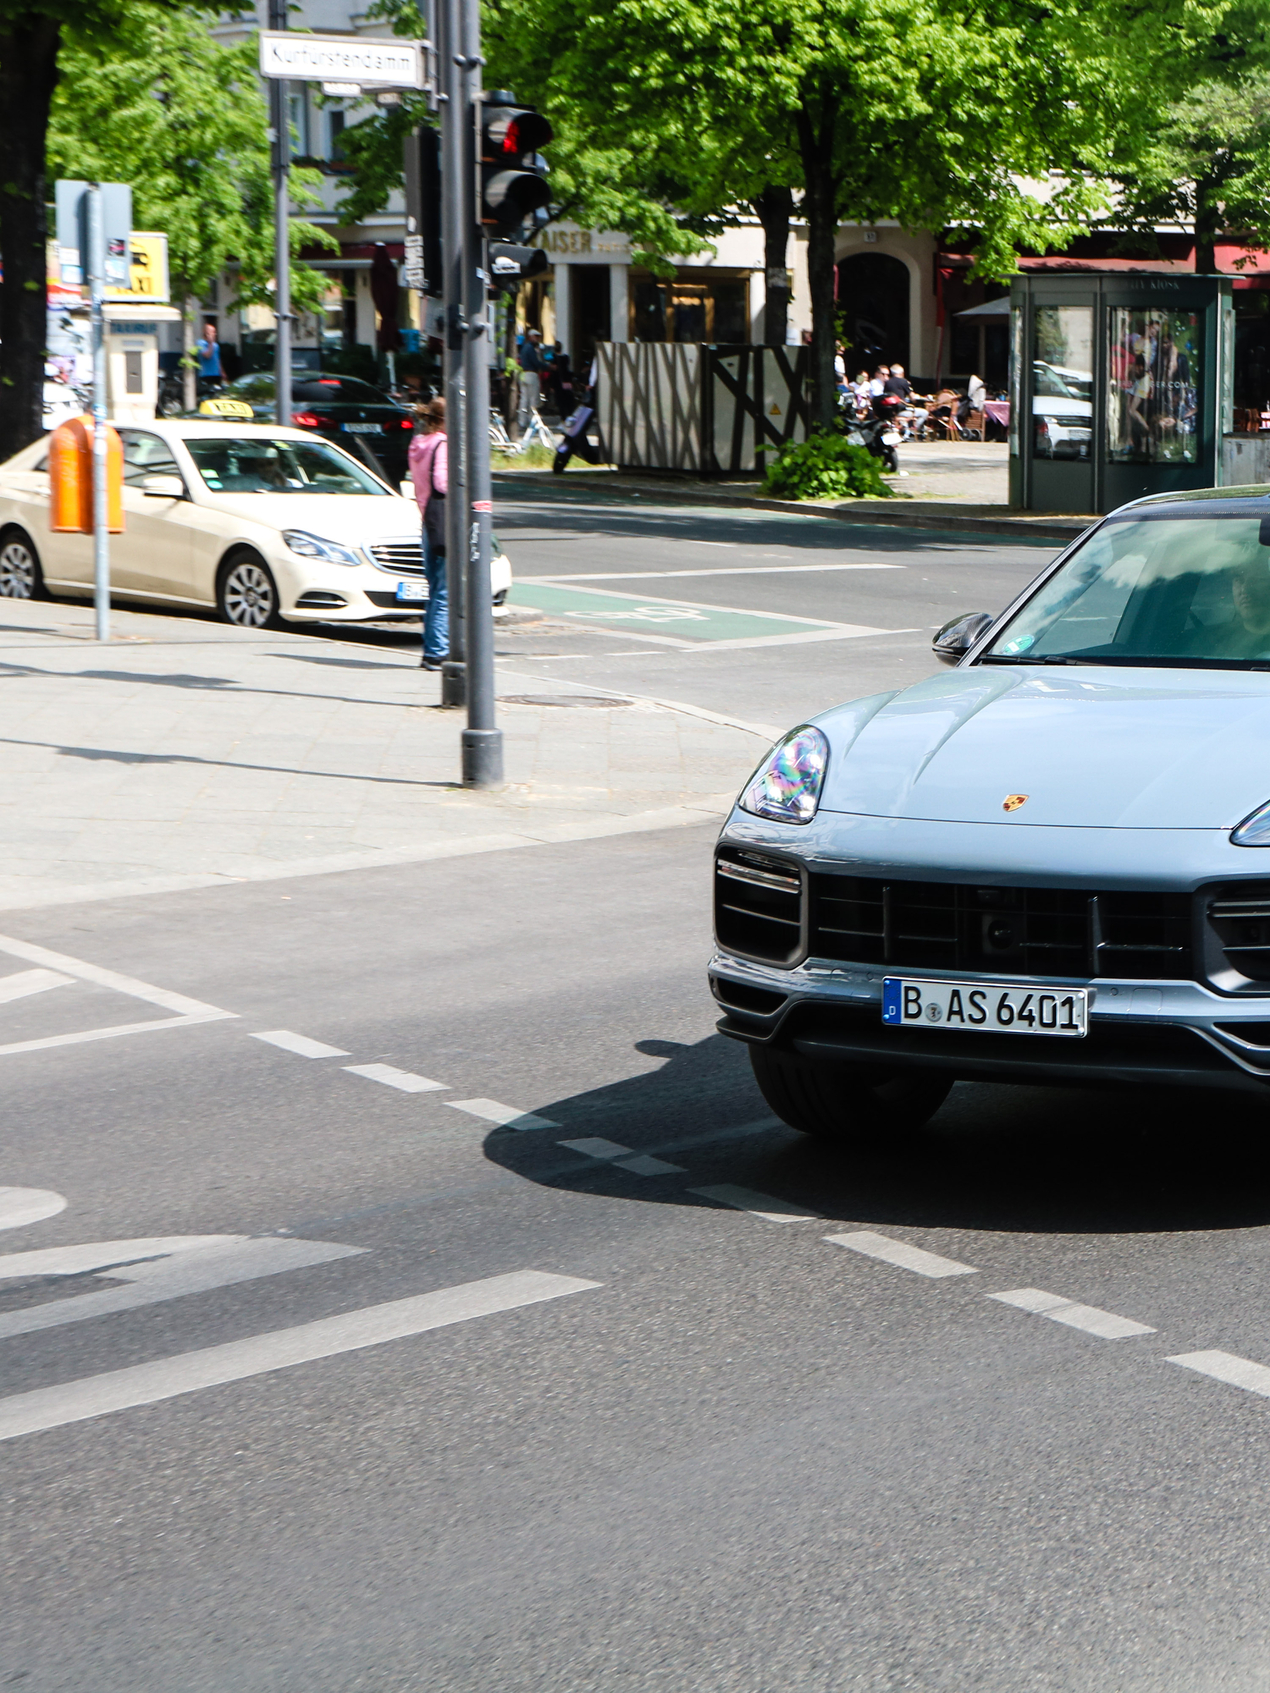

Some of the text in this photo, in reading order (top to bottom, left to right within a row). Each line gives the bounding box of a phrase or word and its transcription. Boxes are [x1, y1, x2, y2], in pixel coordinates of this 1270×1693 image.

[269, 42, 412, 71] Kurfürstendamm
[904, 985, 1080, 1030] B AS 6401
